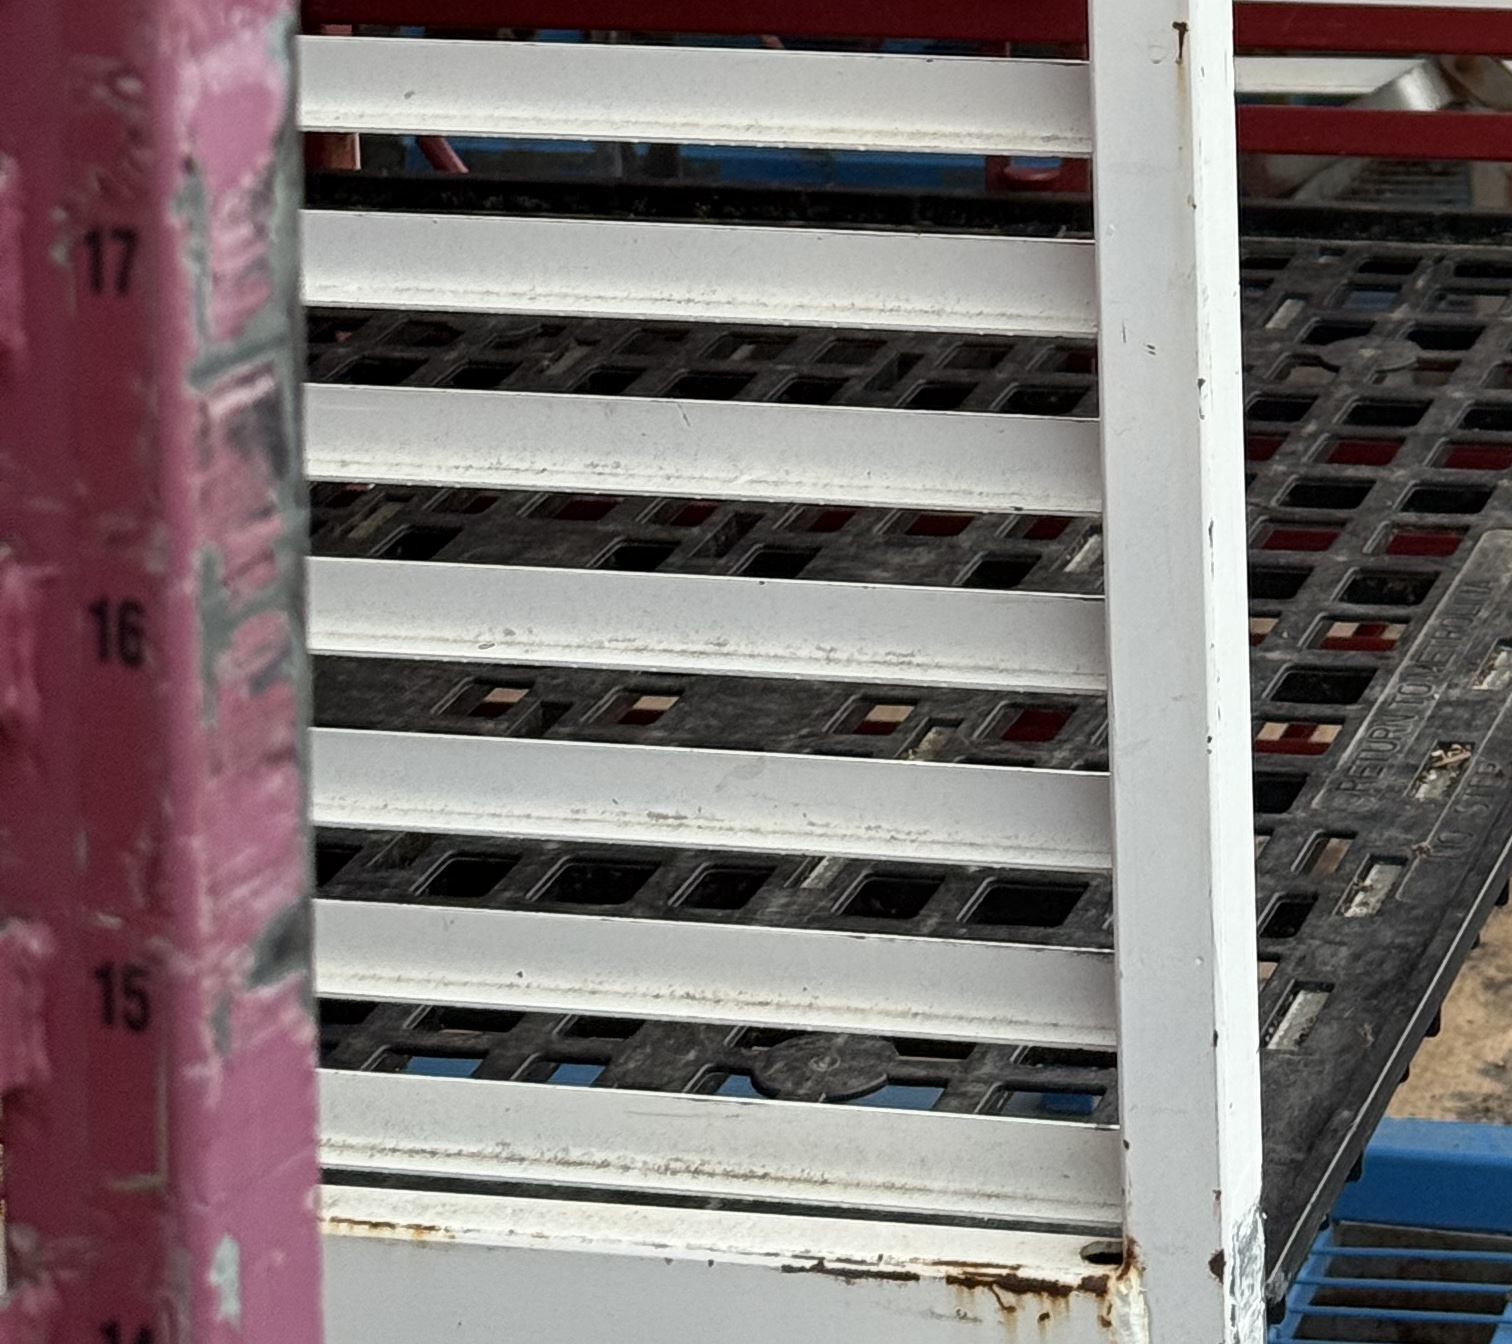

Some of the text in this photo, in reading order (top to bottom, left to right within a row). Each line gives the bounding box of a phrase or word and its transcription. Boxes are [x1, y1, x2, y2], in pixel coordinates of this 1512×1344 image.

[84, 228, 137, 292] 17
[90, 600, 143, 667] 16
[1337, 706, 1421, 795] RETURN
[95, 964, 150, 1032] 15
